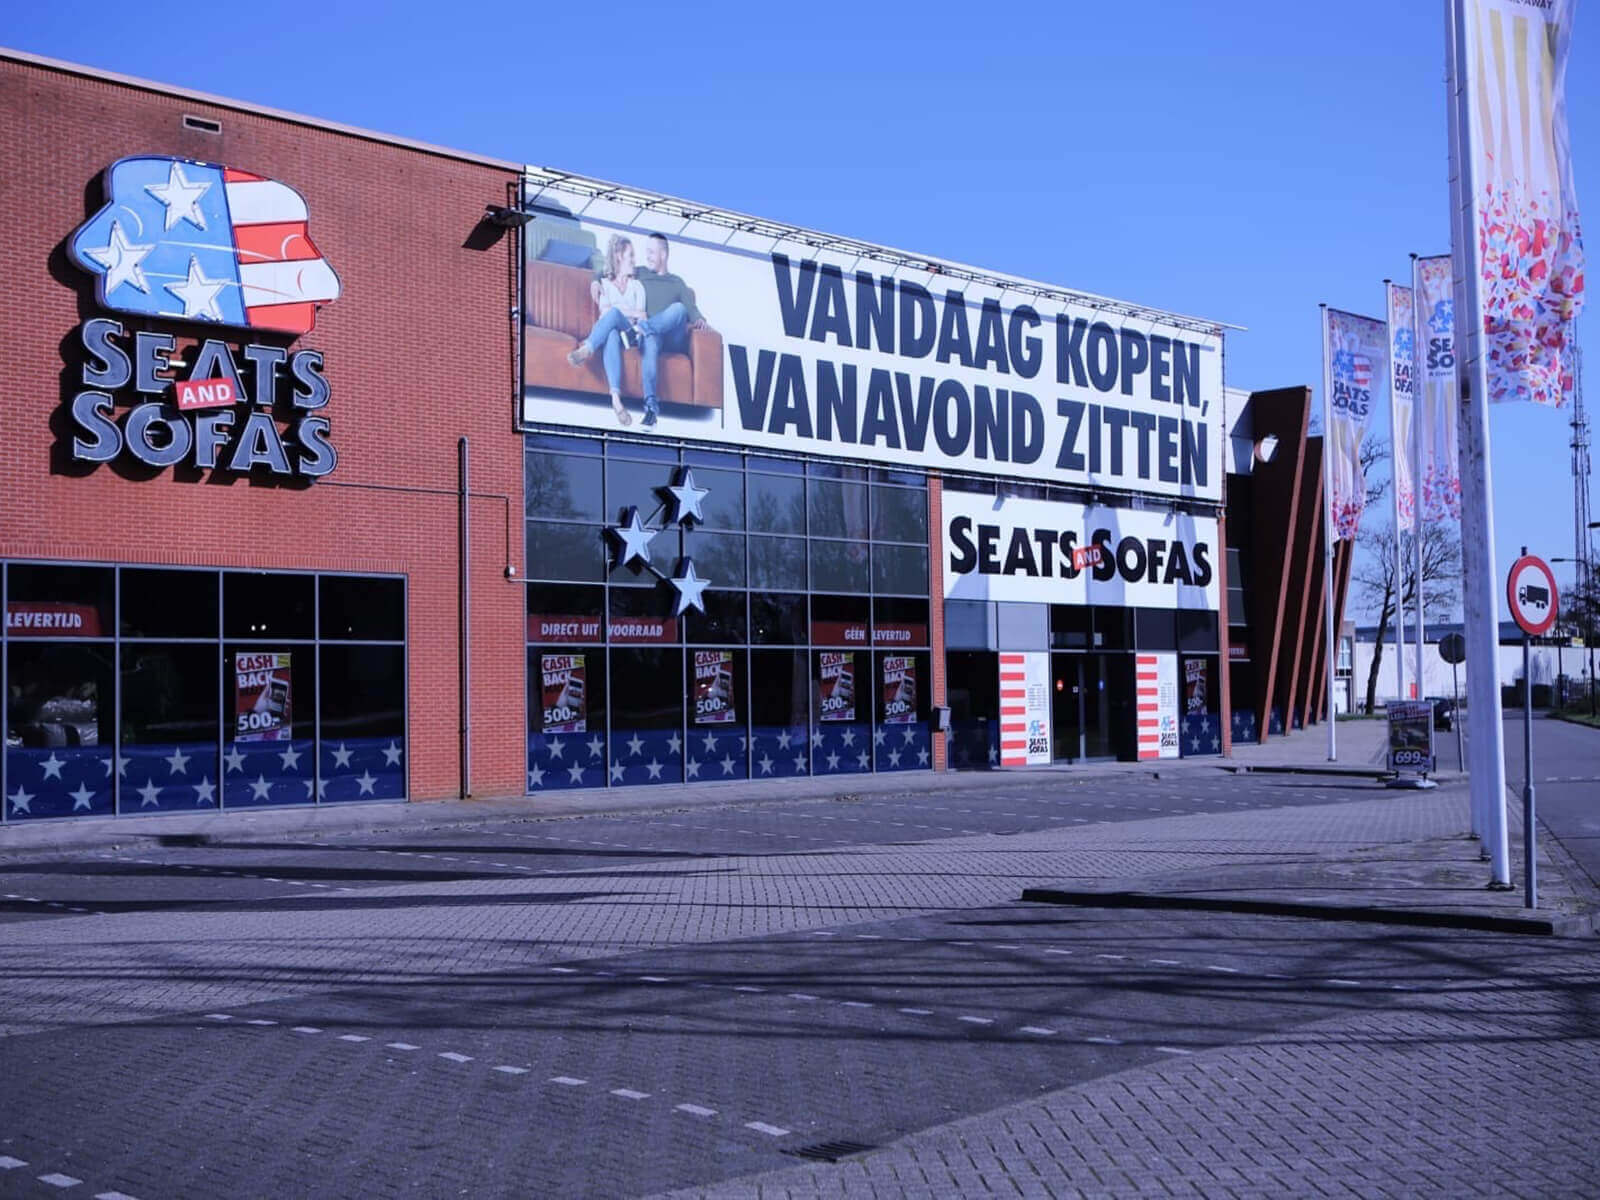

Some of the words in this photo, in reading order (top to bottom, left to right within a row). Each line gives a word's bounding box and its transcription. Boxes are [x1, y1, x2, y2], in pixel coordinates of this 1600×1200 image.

[772, 253, 1042, 379] VANDAAG
[1056, 313, 1210, 417] KOPEN,
[82, 318, 331, 409] SEATS
[181, 384, 232, 408] AND
[729, 344, 1045, 465] VANAVOND
[1056, 398, 1207, 487] ZITTEN
[72, 391, 338, 476] SOFAS
[949, 516, 1080, 579] SEATS
[1076, 550, 1101, 565] AND
[1092, 529, 1212, 587] SOFAS
[6, 612, 82, 628] LEVERTIJD
[541, 623, 579, 636] DIRECT
[581, 623, 599, 636] UIT
[607, 624, 664, 637] VOORRAAD
[872, 629, 911, 641] LEVERTIJD
[238, 655, 274, 672] CASH
[544, 656, 571, 671] CASH
[238, 671, 274, 689] BACK
